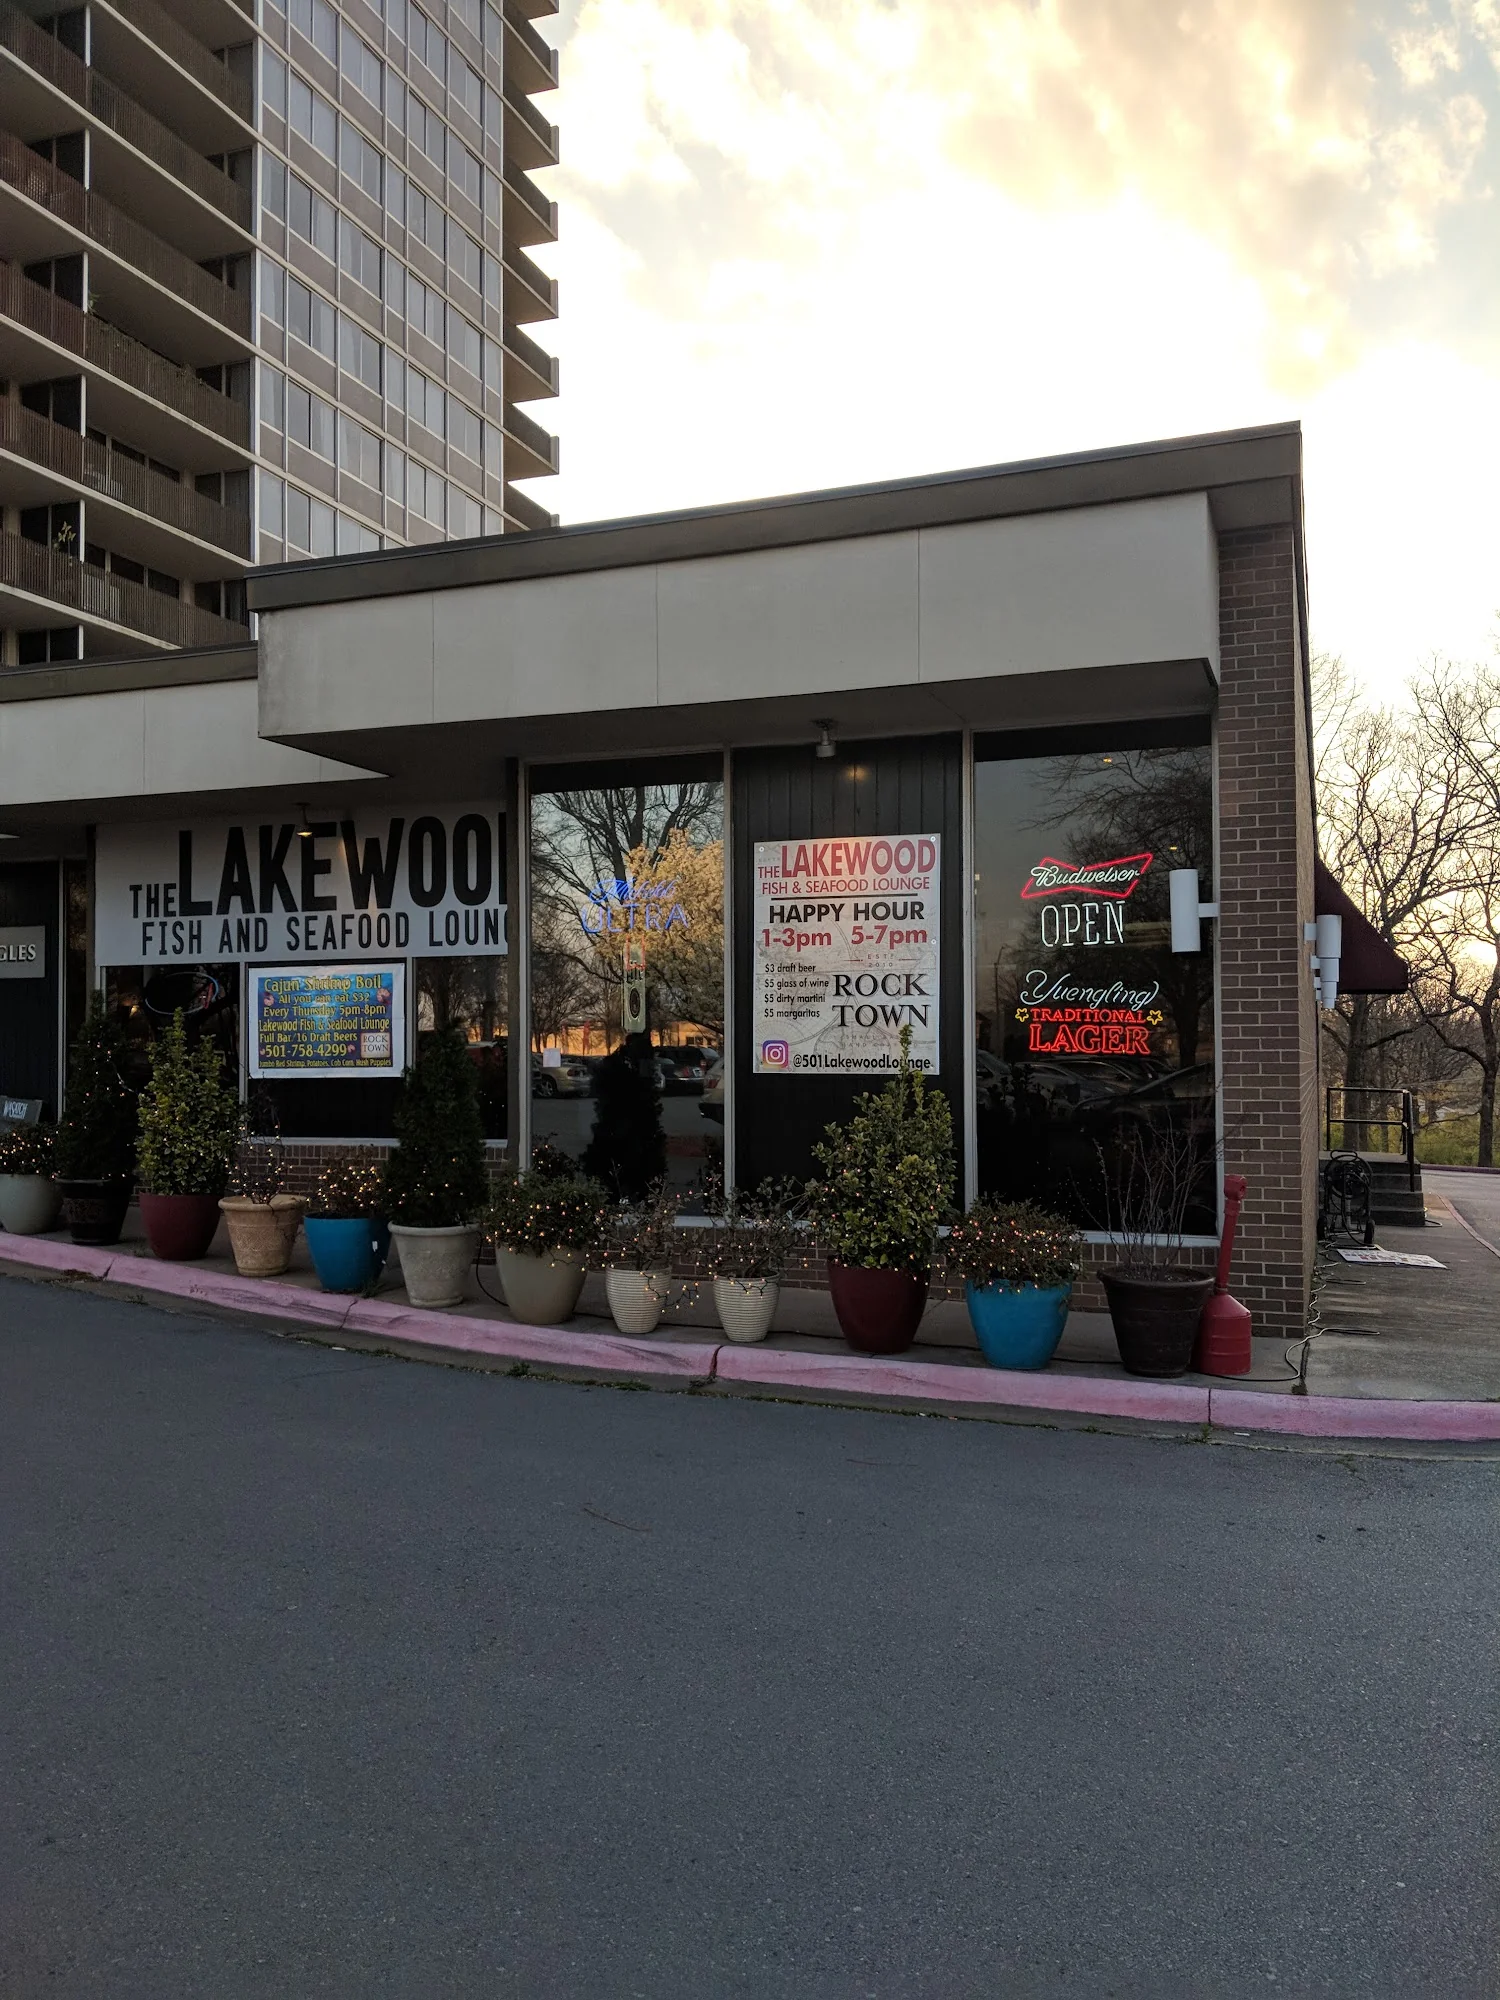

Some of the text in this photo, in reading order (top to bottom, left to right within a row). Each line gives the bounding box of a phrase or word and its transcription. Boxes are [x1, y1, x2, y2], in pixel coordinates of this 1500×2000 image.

[758, 839, 936, 878] THE LAKEWOOD
[1031, 866, 1141, 886] Budweiser
[762, 877, 930, 895] FISH & SEAFOOD LOUNGE
[129, 882, 177, 918] THE
[581, 902, 690, 934] ULTRA
[769, 901, 925, 923] HAPPY HOUR
[141, 907, 508, 956] FISH AND SEAFOOD LOUN
[1041, 901, 1125, 947] OPEN
[762, 925, 927, 952] 1-3pm 5-7pm
[765, 962, 816, 973] $3 draft beer
[264, 974, 381, 994] Cajun Shrimp Boil
[764, 978, 829, 990] $5 glass of wine
[832, 974, 930, 996] ROCK
[1020, 970, 1159, 1011] Yuengling
[278, 995, 291, 1004] All
[294, 995, 311, 1005] you
[335, 993, 349, 1001] eat
[352, 992, 370, 1002] $32
[764, 993, 826, 1005] $5 dirty martini
[263, 1005, 386, 1018] Every Thursday 5pm-8pm
[764, 1008, 820, 1020] $5 margaritas
[832, 1004, 931, 1028] TOWN
[1031, 1008, 1146, 1023] TRADITIONAL
[259, 1018, 390, 1032] Lakewood Fish & Seafood Lounge
[260, 1033, 274, 1043] Full
[310, 1032, 331, 1042] Draft
[334, 1031, 357, 1041] Beers
[363, 1035, 388, 1043] ROCK
[1029, 1024, 1150, 1054] LAGER
[265, 1044, 347, 1057] 501-758-4299
[363, 1044, 389, 1053] TOWN
[370, 1058, 392, 1067] Puppies
